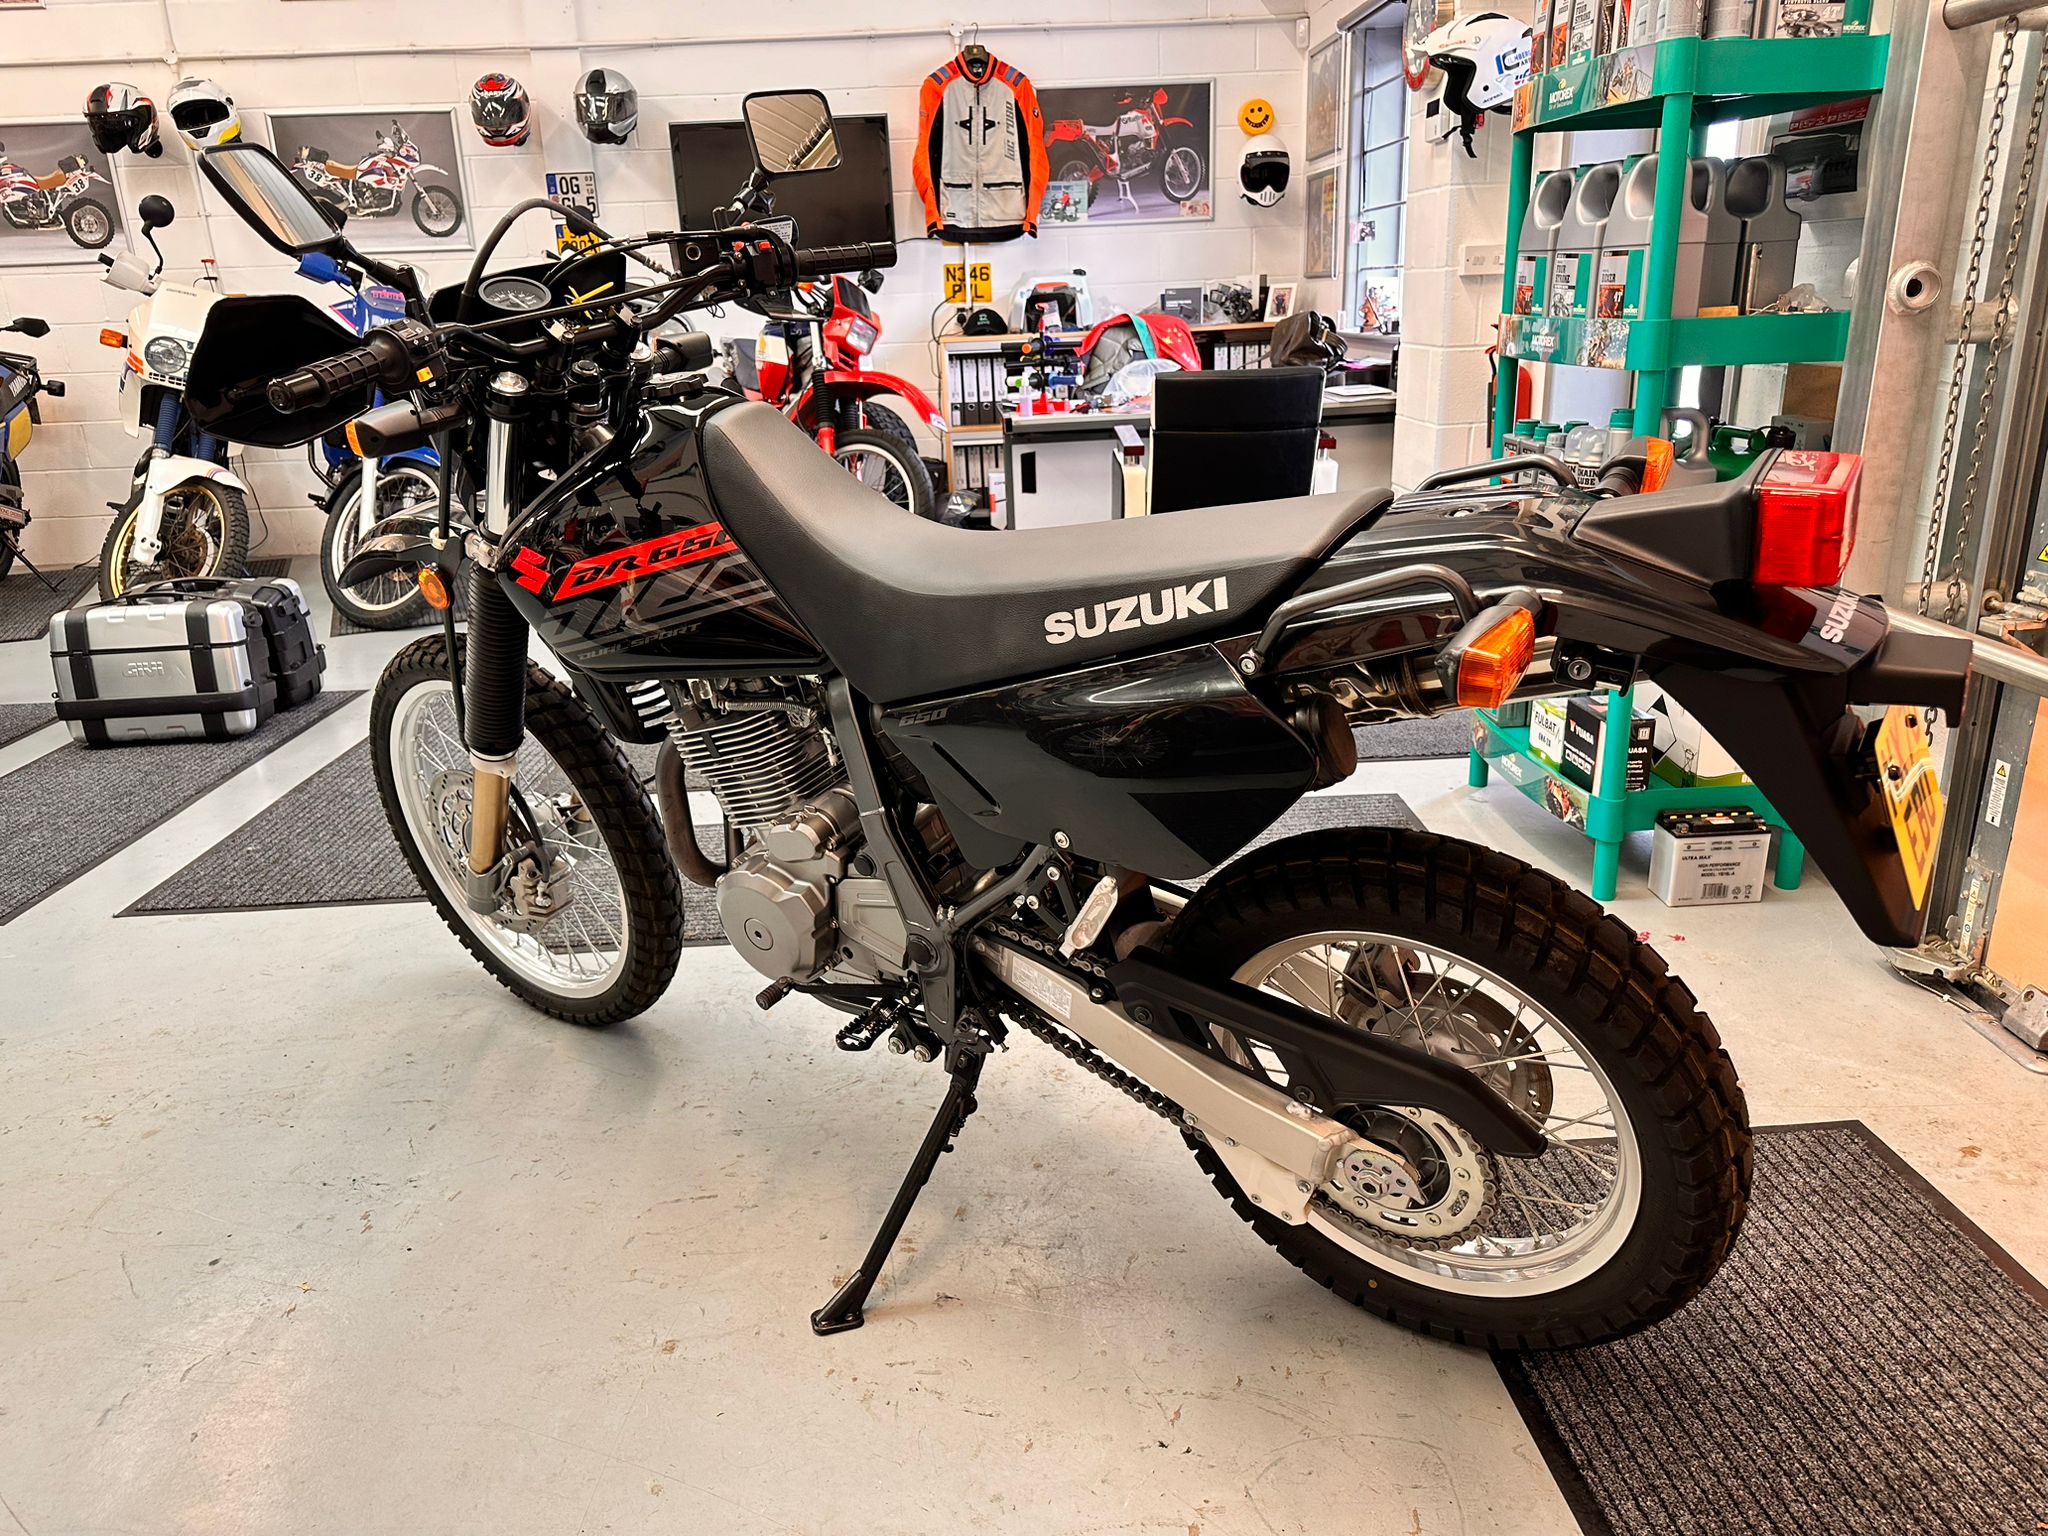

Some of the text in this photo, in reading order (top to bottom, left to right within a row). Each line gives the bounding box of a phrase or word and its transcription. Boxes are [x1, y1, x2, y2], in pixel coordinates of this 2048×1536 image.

[1823, 6, 1841, 19] 4T
[1549, 86, 1574, 104] MOTOREX
[308, 170, 322, 182] 38
[72, 179, 85, 193] 38
[559, 176, 581, 195] OG
[1532, 335, 1555, 348] MOTOREX
[1044, 576, 1229, 645] SUZUKI
[899, 705, 951, 727] 650
[1534, 711, 1557, 732] FULBAT
[1574, 724, 1595, 746] YUASA
